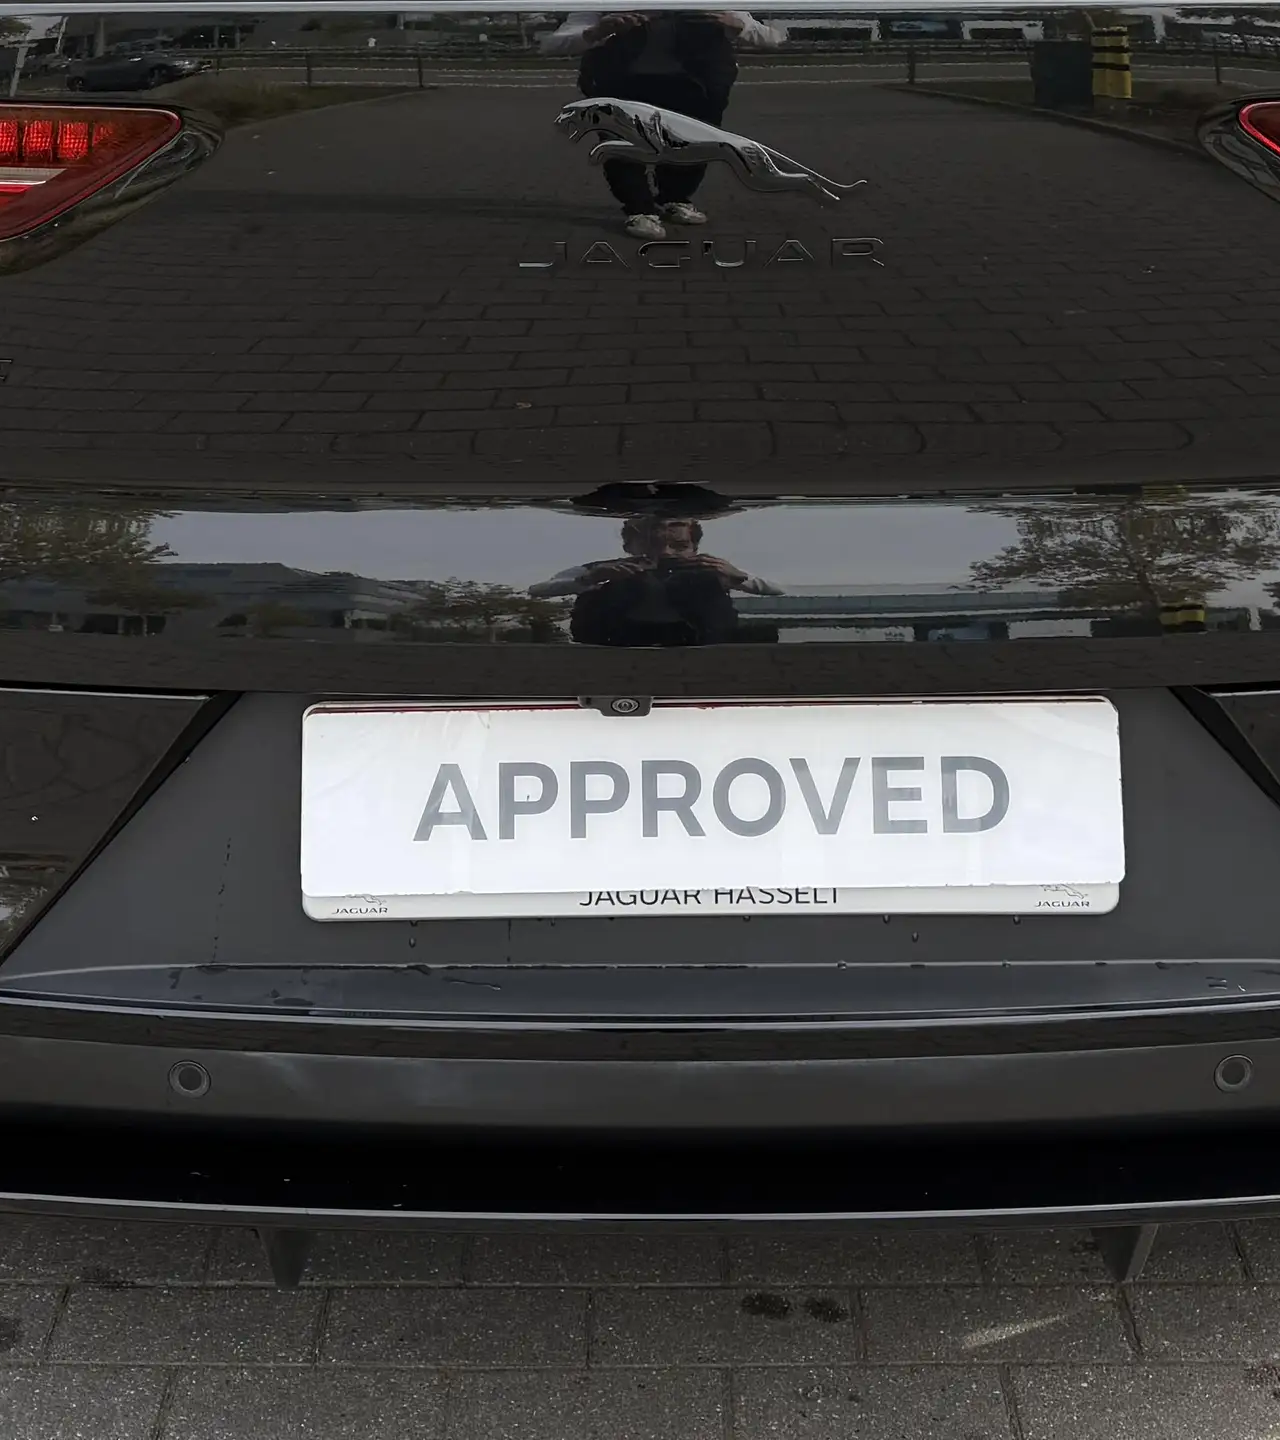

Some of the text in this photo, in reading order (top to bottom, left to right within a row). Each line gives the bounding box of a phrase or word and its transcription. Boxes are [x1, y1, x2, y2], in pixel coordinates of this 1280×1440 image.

[519, 237, 886, 269] JAGUAR
[412, 755, 1012, 842] APPROVED
[579, 890, 701, 906] JAGUAR
[1035, 900, 1091, 908] JAGUAR
[331, 907, 389, 915] JAGUAR
